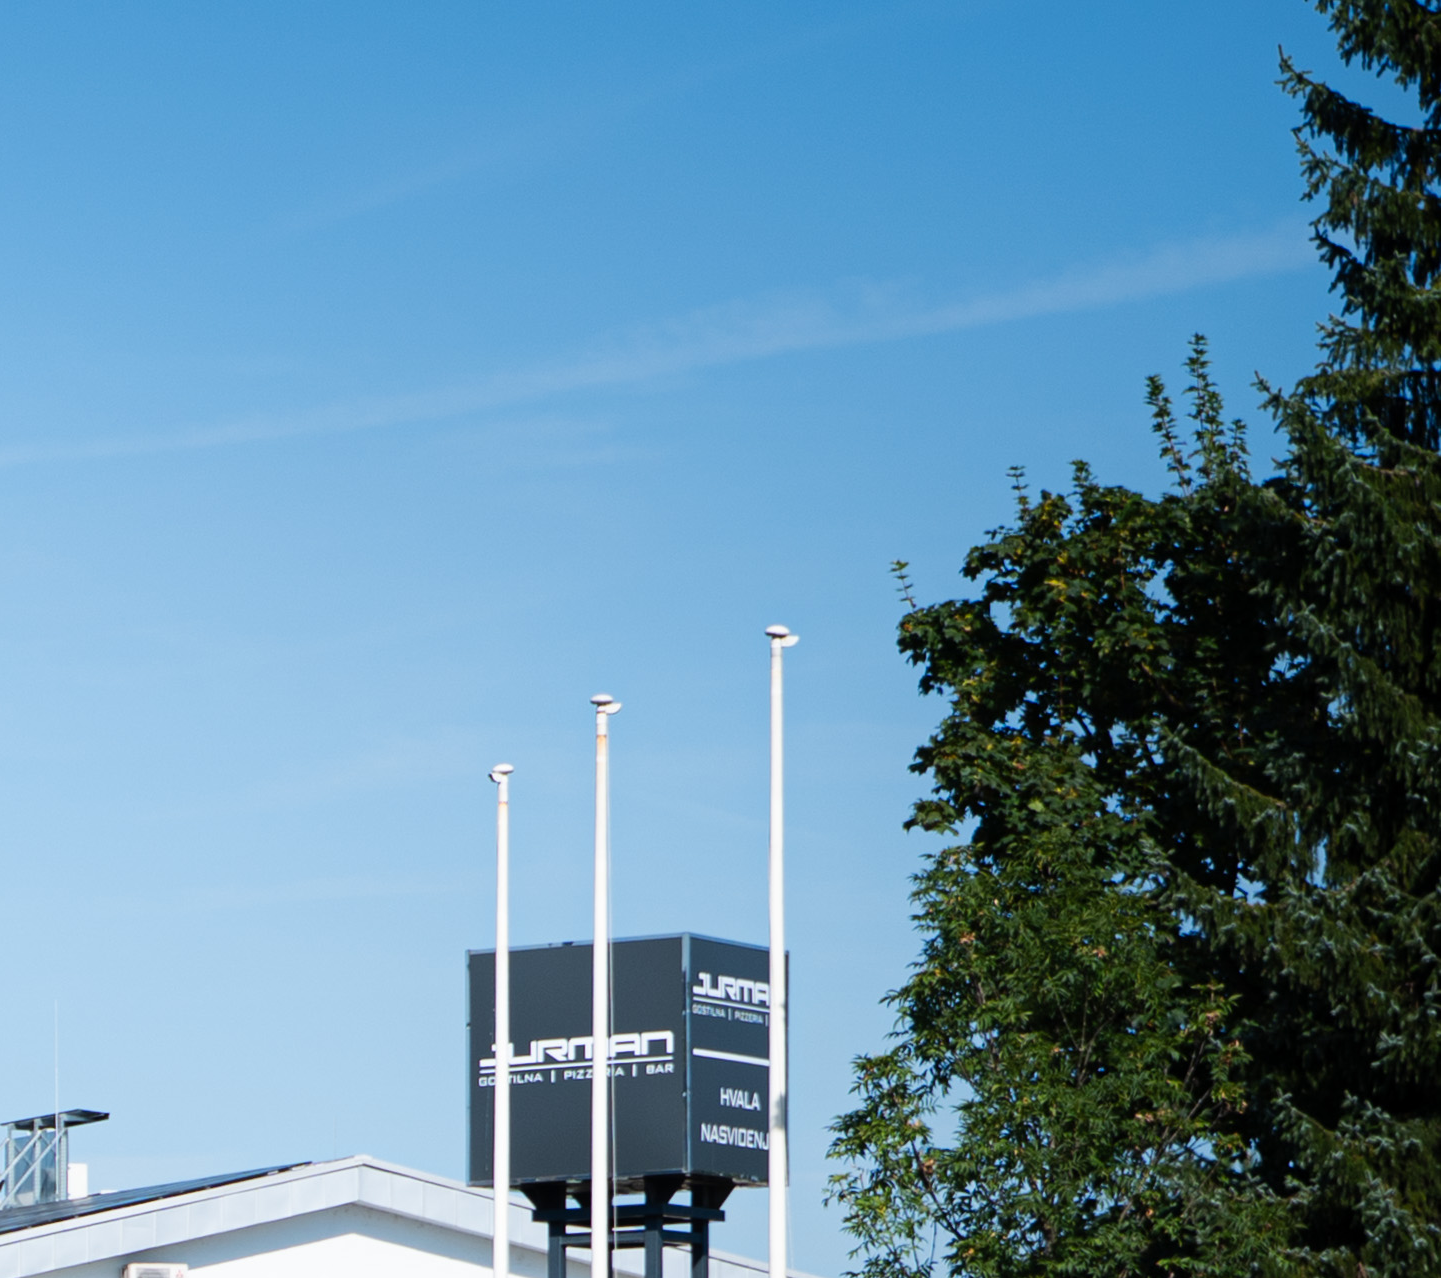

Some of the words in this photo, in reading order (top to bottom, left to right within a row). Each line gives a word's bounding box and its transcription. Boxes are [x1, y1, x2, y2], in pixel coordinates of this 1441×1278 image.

[692, 972, 770, 1006] JURMA
[692, 1004, 726, 1018] GOSTILNA
[734, 1011, 764, 1024] PIZZERIA
[478, 1071, 543, 1087] GOTILNA
[645, 1064, 674, 1075] BAR
[720, 1087, 761, 1111] HVALA
[701, 1123, 770, 1150] NASVIDENJ
